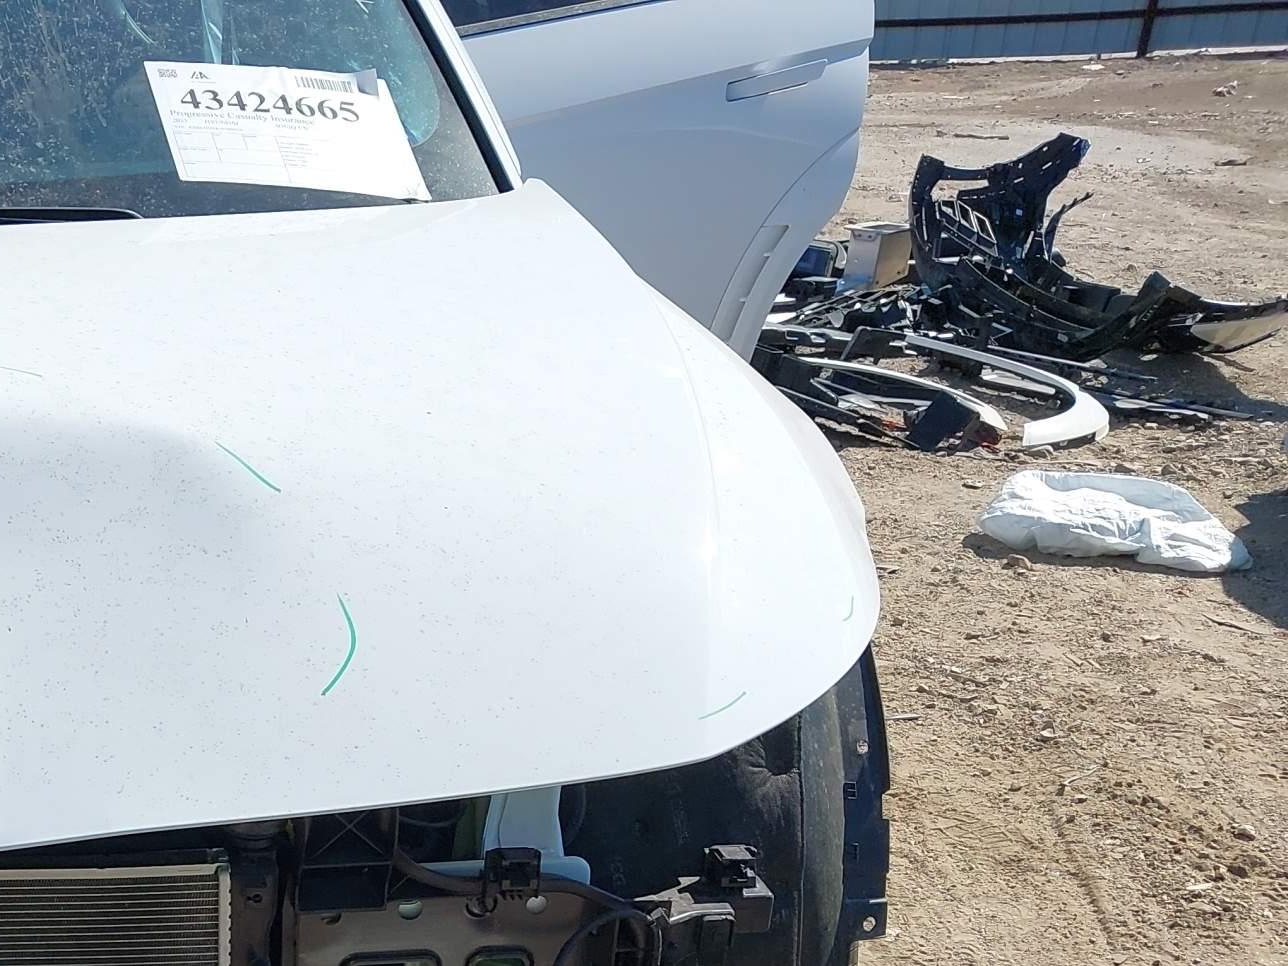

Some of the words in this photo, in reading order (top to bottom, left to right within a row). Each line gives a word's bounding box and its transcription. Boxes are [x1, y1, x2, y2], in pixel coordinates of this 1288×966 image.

[170, 109, 225, 120] Progressive
[270, 114, 315, 125] Insurance
[180, 88, 360, 123] 43424665
